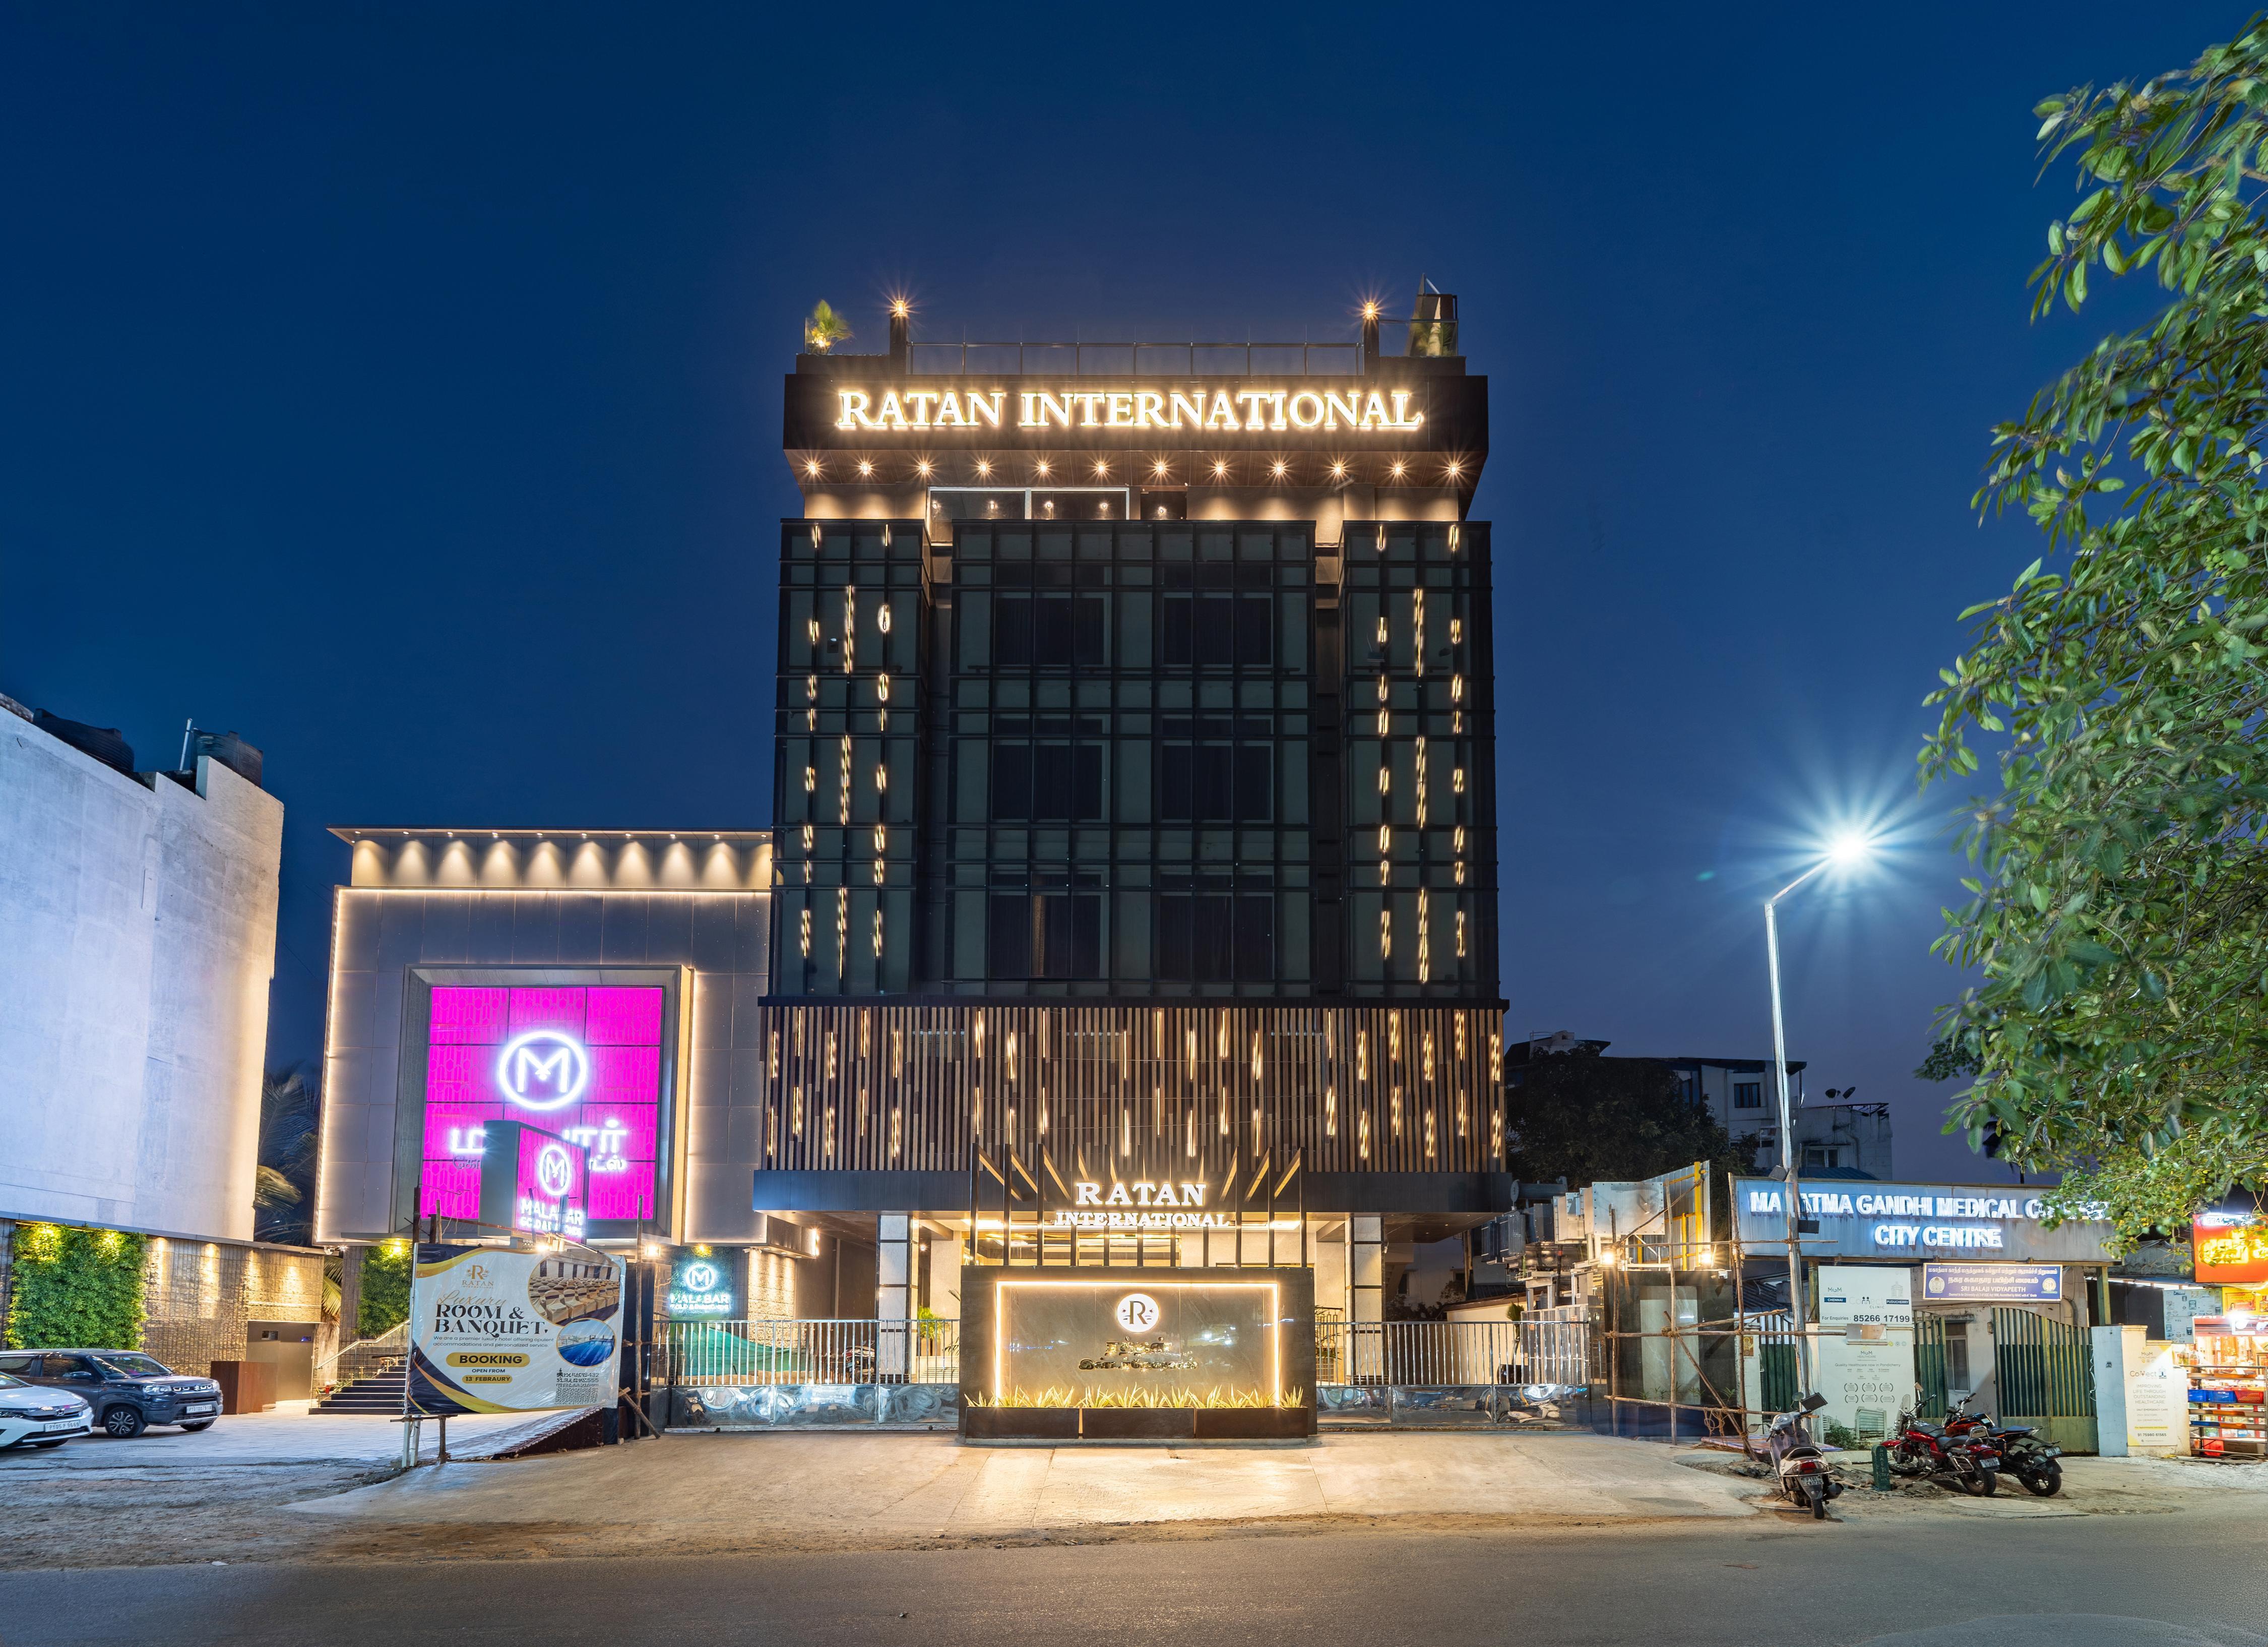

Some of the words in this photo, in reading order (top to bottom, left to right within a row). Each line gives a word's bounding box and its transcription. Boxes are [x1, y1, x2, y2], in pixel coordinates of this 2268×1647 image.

[837, 391, 1003, 429] RATAN
[1019, 391, 1423, 431] INTERNATIONAL
[1076, 1182, 1207, 1206] RATAN
[521, 1198, 583, 1226] MALAAR
[1856, 1195, 1933, 1216] GANDHI
[1936, 1197, 2024, 1219] MEDICAL
[1055, 1211, 1230, 1228] INTERNATIONAL
[1874, 1225, 1921, 1246] CITY
[1922, 1226, 2003, 1248] CENTRE
[436, 1290, 507, 1309] Luxury
[435, 1304, 501, 1319] ROOM
[509, 1306, 525, 1319] &
[459, 1355, 523, 1364] BOOKING
